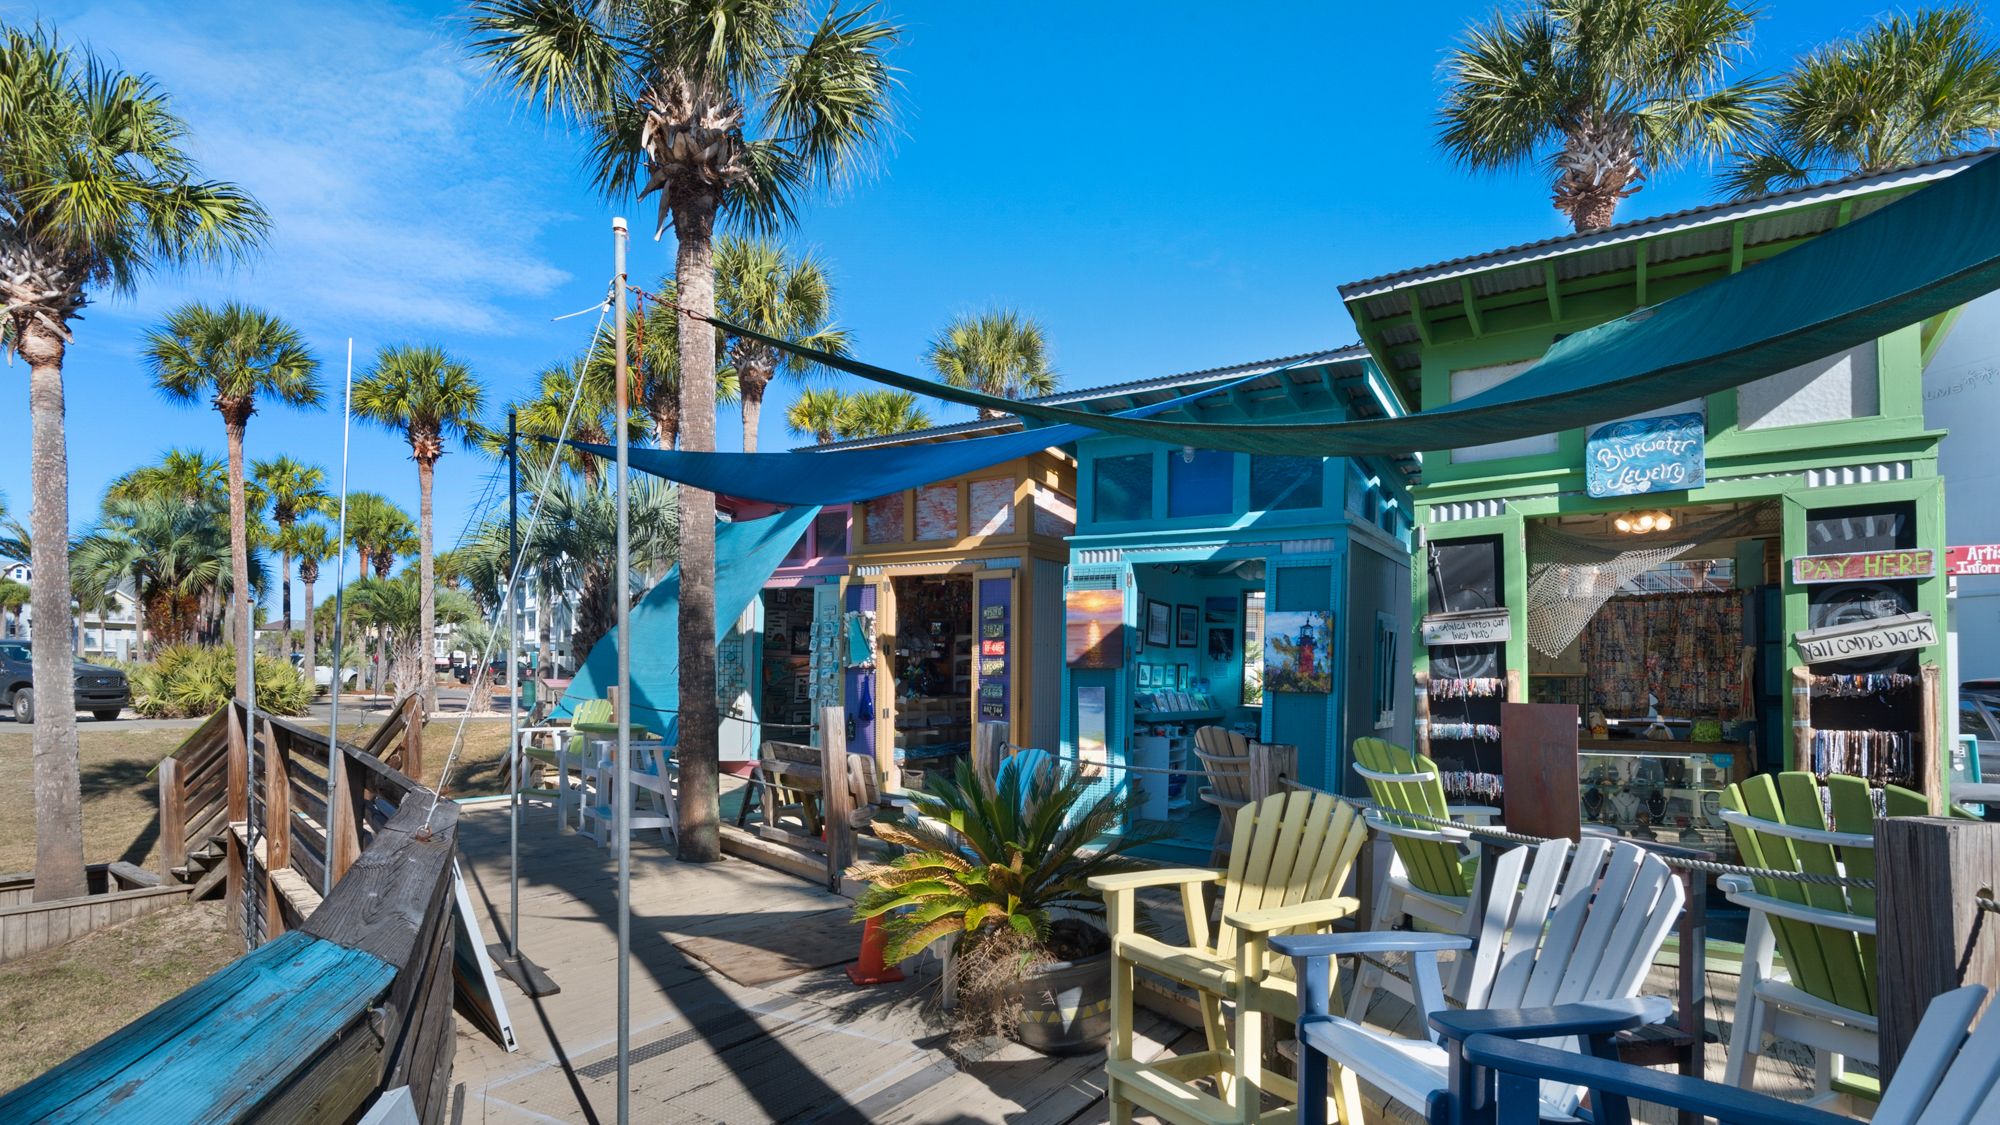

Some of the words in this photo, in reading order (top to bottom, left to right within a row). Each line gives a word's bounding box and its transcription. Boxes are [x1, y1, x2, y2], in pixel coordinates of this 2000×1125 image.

[1597, 436, 1696, 472] Bluewater
[1607, 462, 1685, 489] Jewelry
[1800, 557, 1850, 581] PAY
[1864, 552, 1929, 577] HERE
[1492, 618, 1504, 628] cat
[1837, 635, 1883, 654] come
